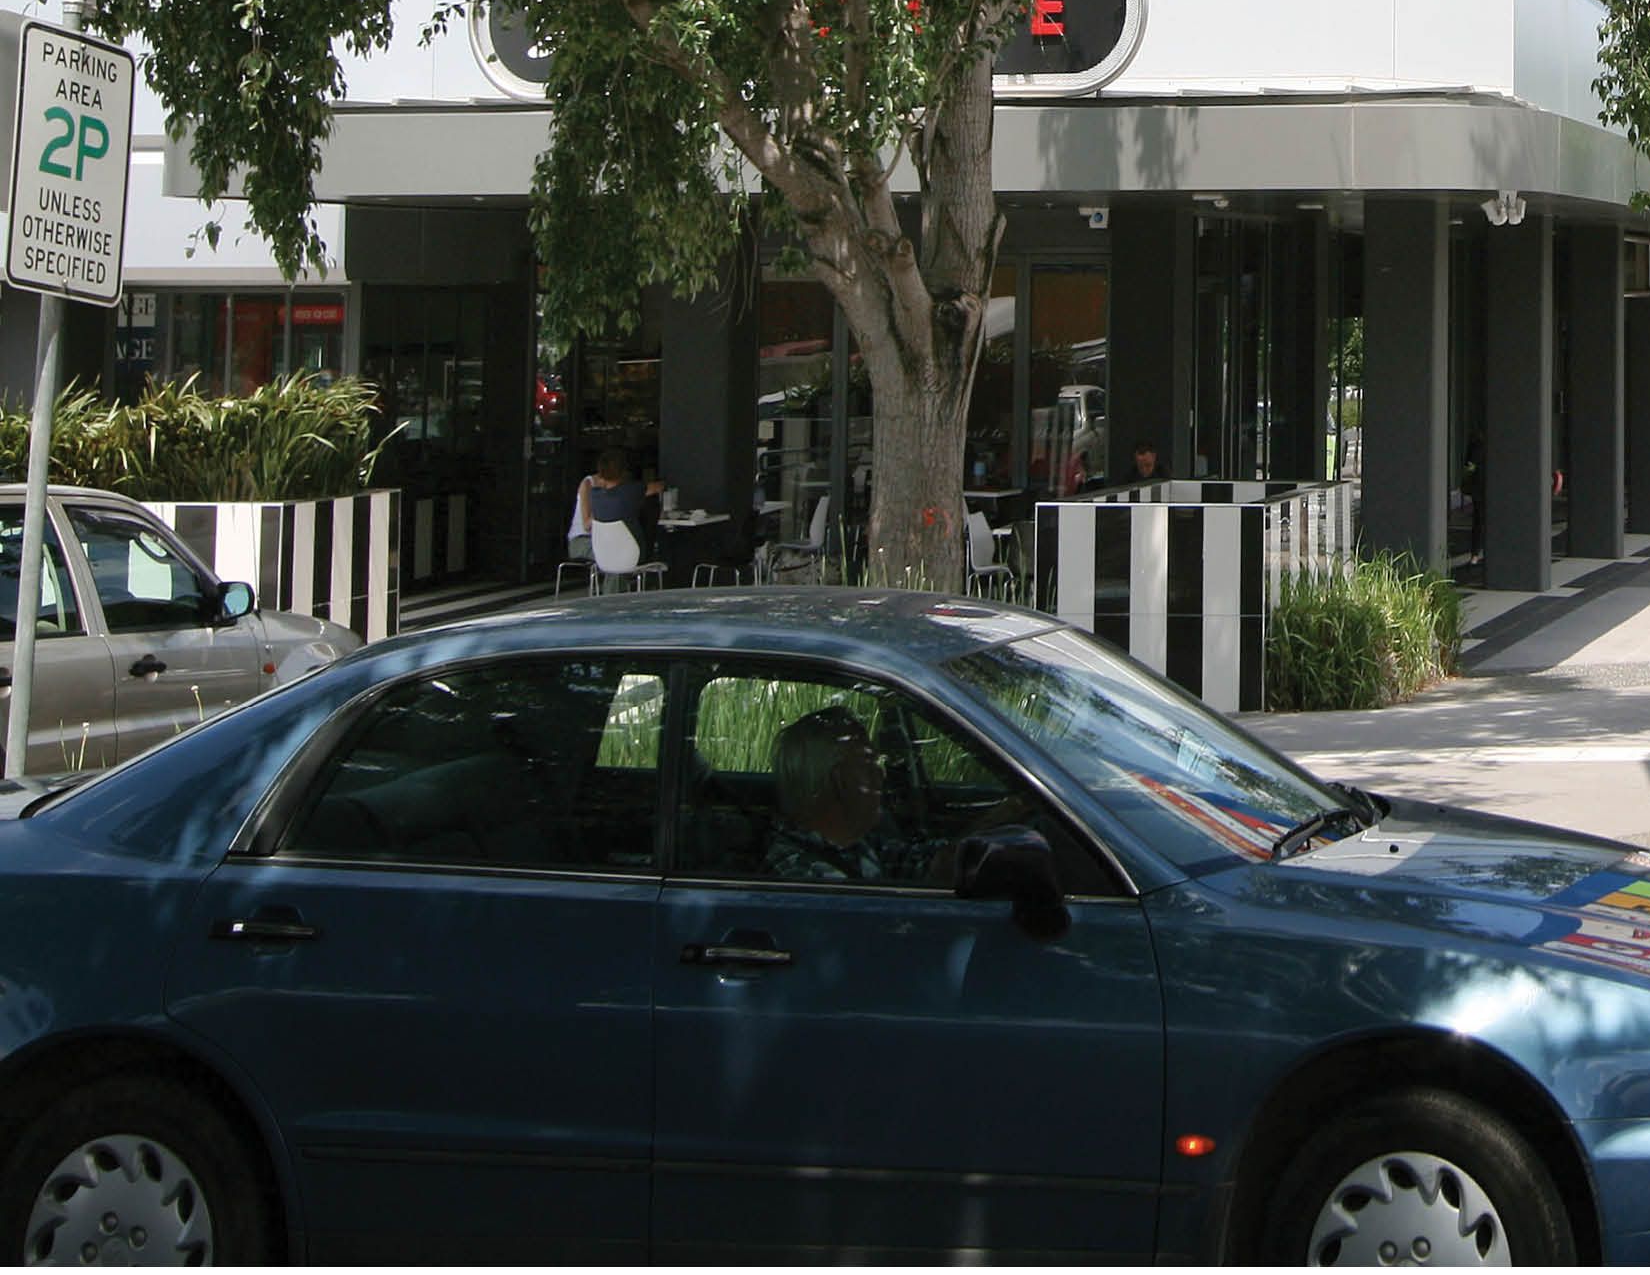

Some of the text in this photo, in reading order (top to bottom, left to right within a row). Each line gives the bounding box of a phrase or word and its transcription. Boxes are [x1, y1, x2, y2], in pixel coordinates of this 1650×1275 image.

[42, 42, 117, 83] PARKING
[56, 78, 103, 110] AREA
[39, 106, 110, 181] 2P
[38, 187, 101, 223] UNLESS
[22, 215, 112, 256] OTHERWISE
[24, 246, 106, 284] SPECIFIED
